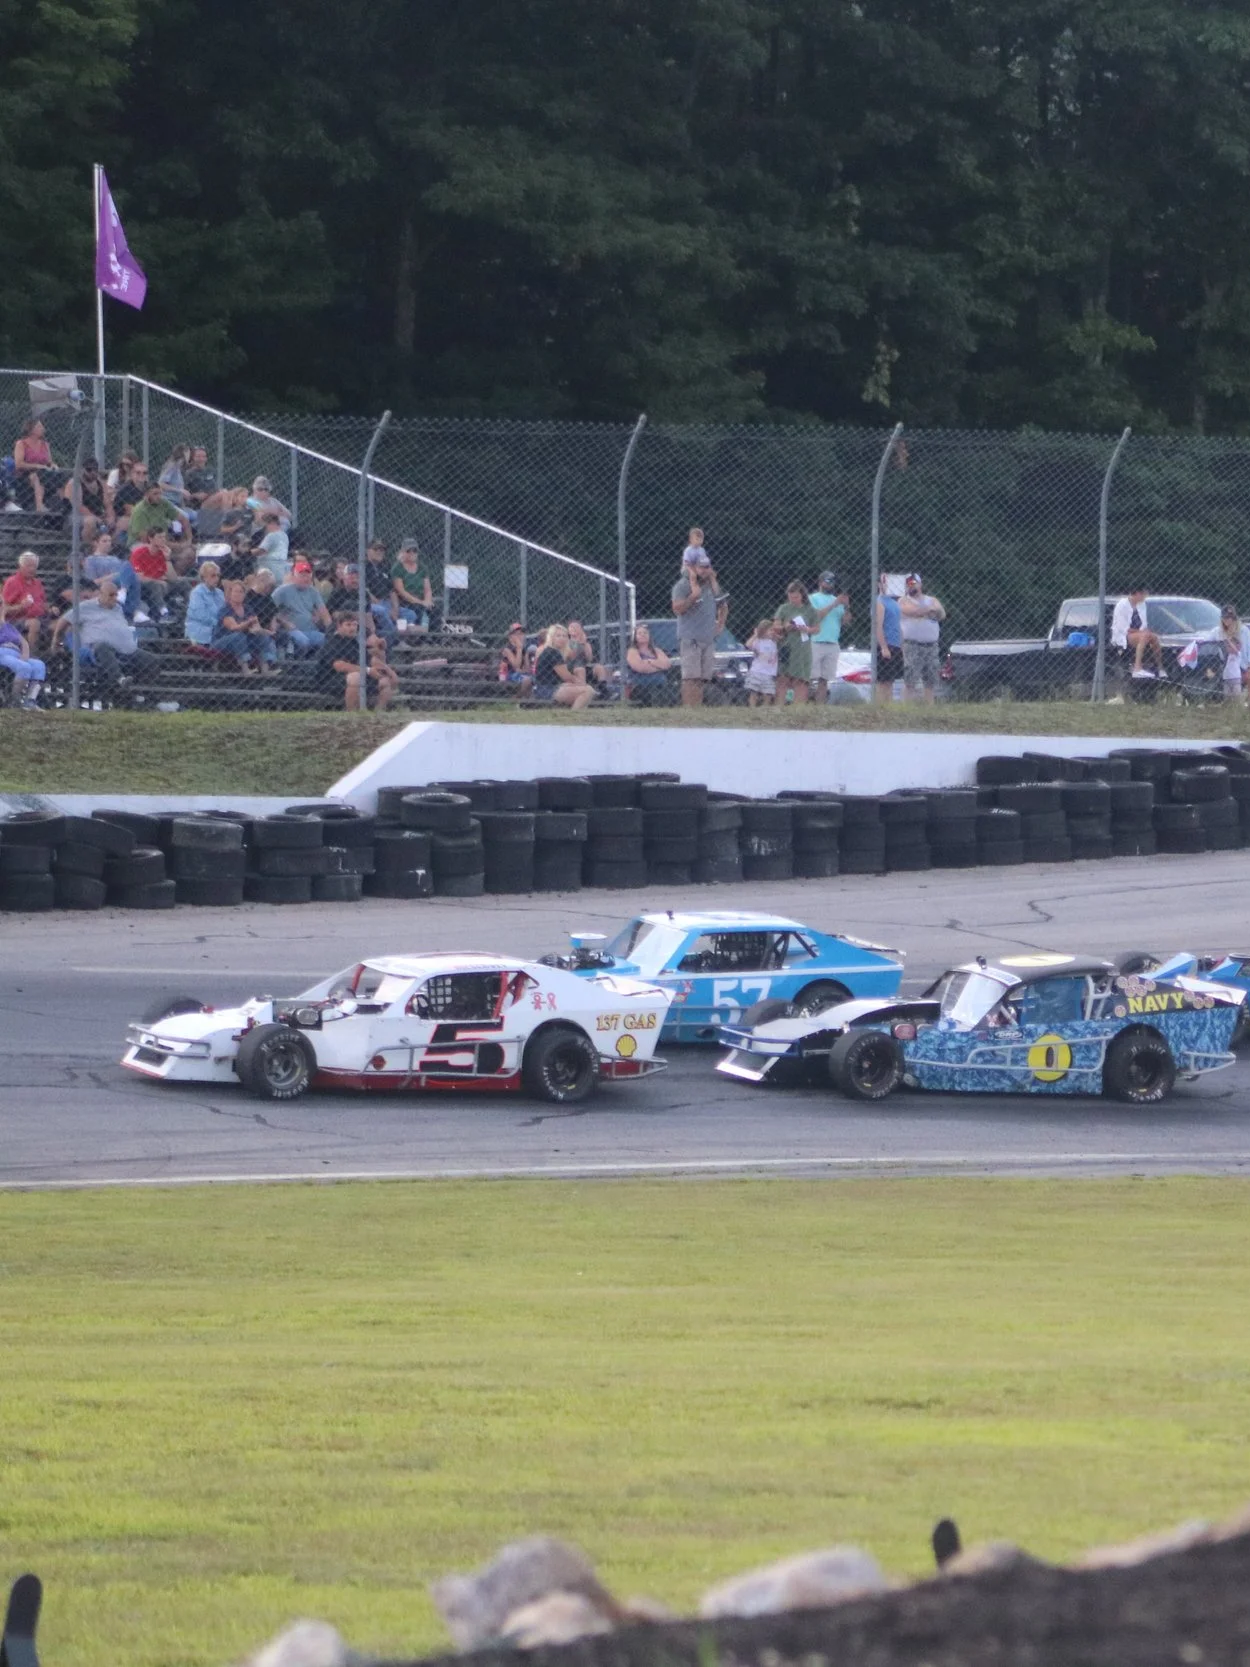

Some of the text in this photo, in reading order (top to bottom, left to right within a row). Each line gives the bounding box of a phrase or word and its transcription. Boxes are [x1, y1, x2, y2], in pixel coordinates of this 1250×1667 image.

[711, 979, 772, 1027] 57
[1127, 991, 1184, 1014] NAVY
[623, 1012, 657, 1030] GAS
[418, 1015, 505, 1083] 5
